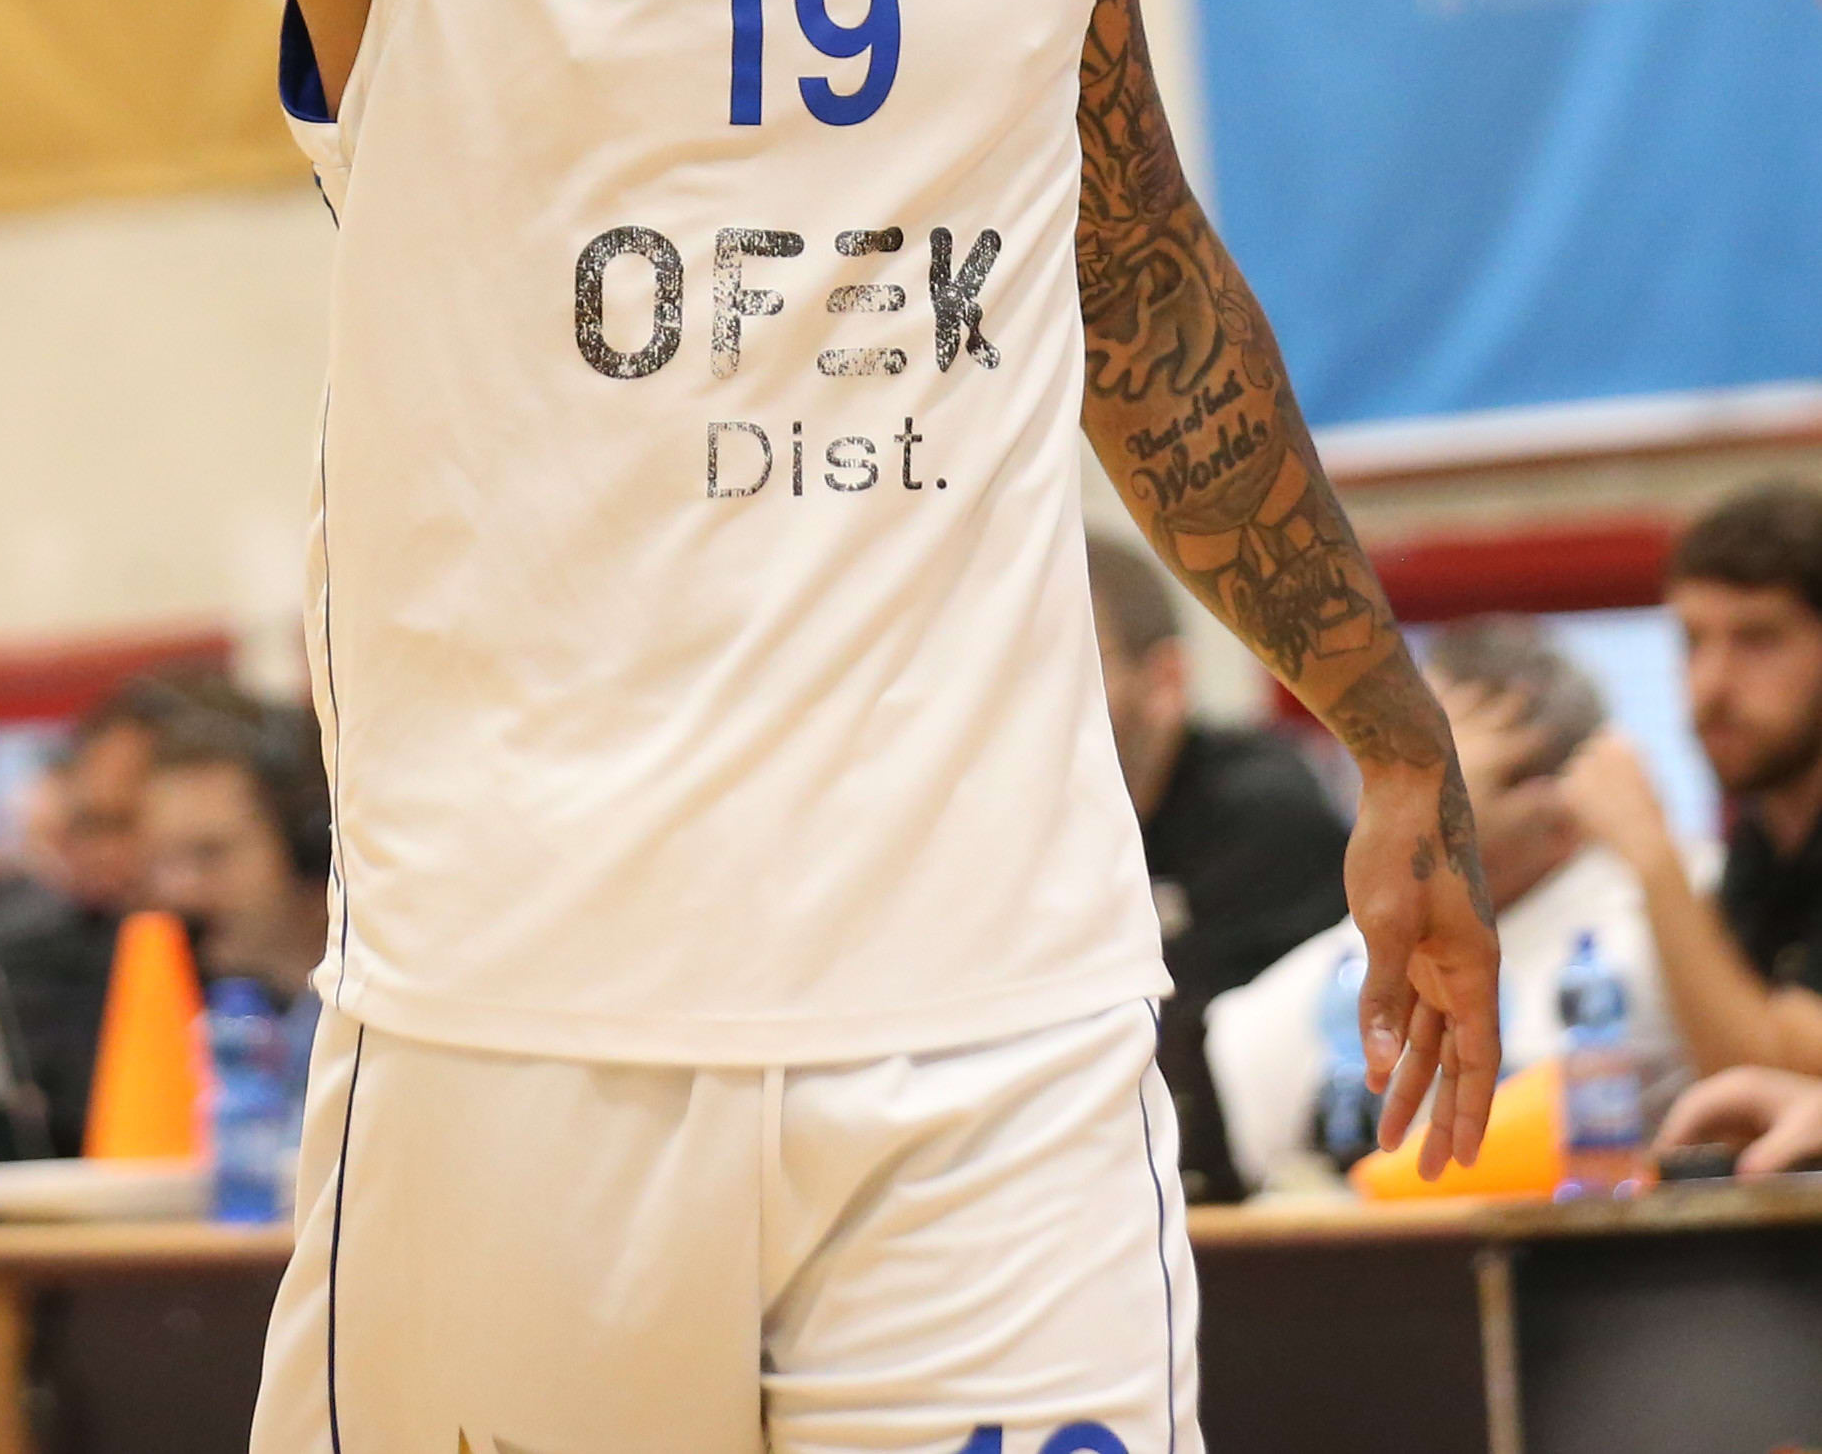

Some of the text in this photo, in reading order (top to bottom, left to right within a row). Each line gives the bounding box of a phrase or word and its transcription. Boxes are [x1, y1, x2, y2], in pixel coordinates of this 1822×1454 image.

[574, 225, 1003, 380] OFEK
[706, 416, 950, 499] Dist.
[1131, 412, 1269, 510] Worlds
